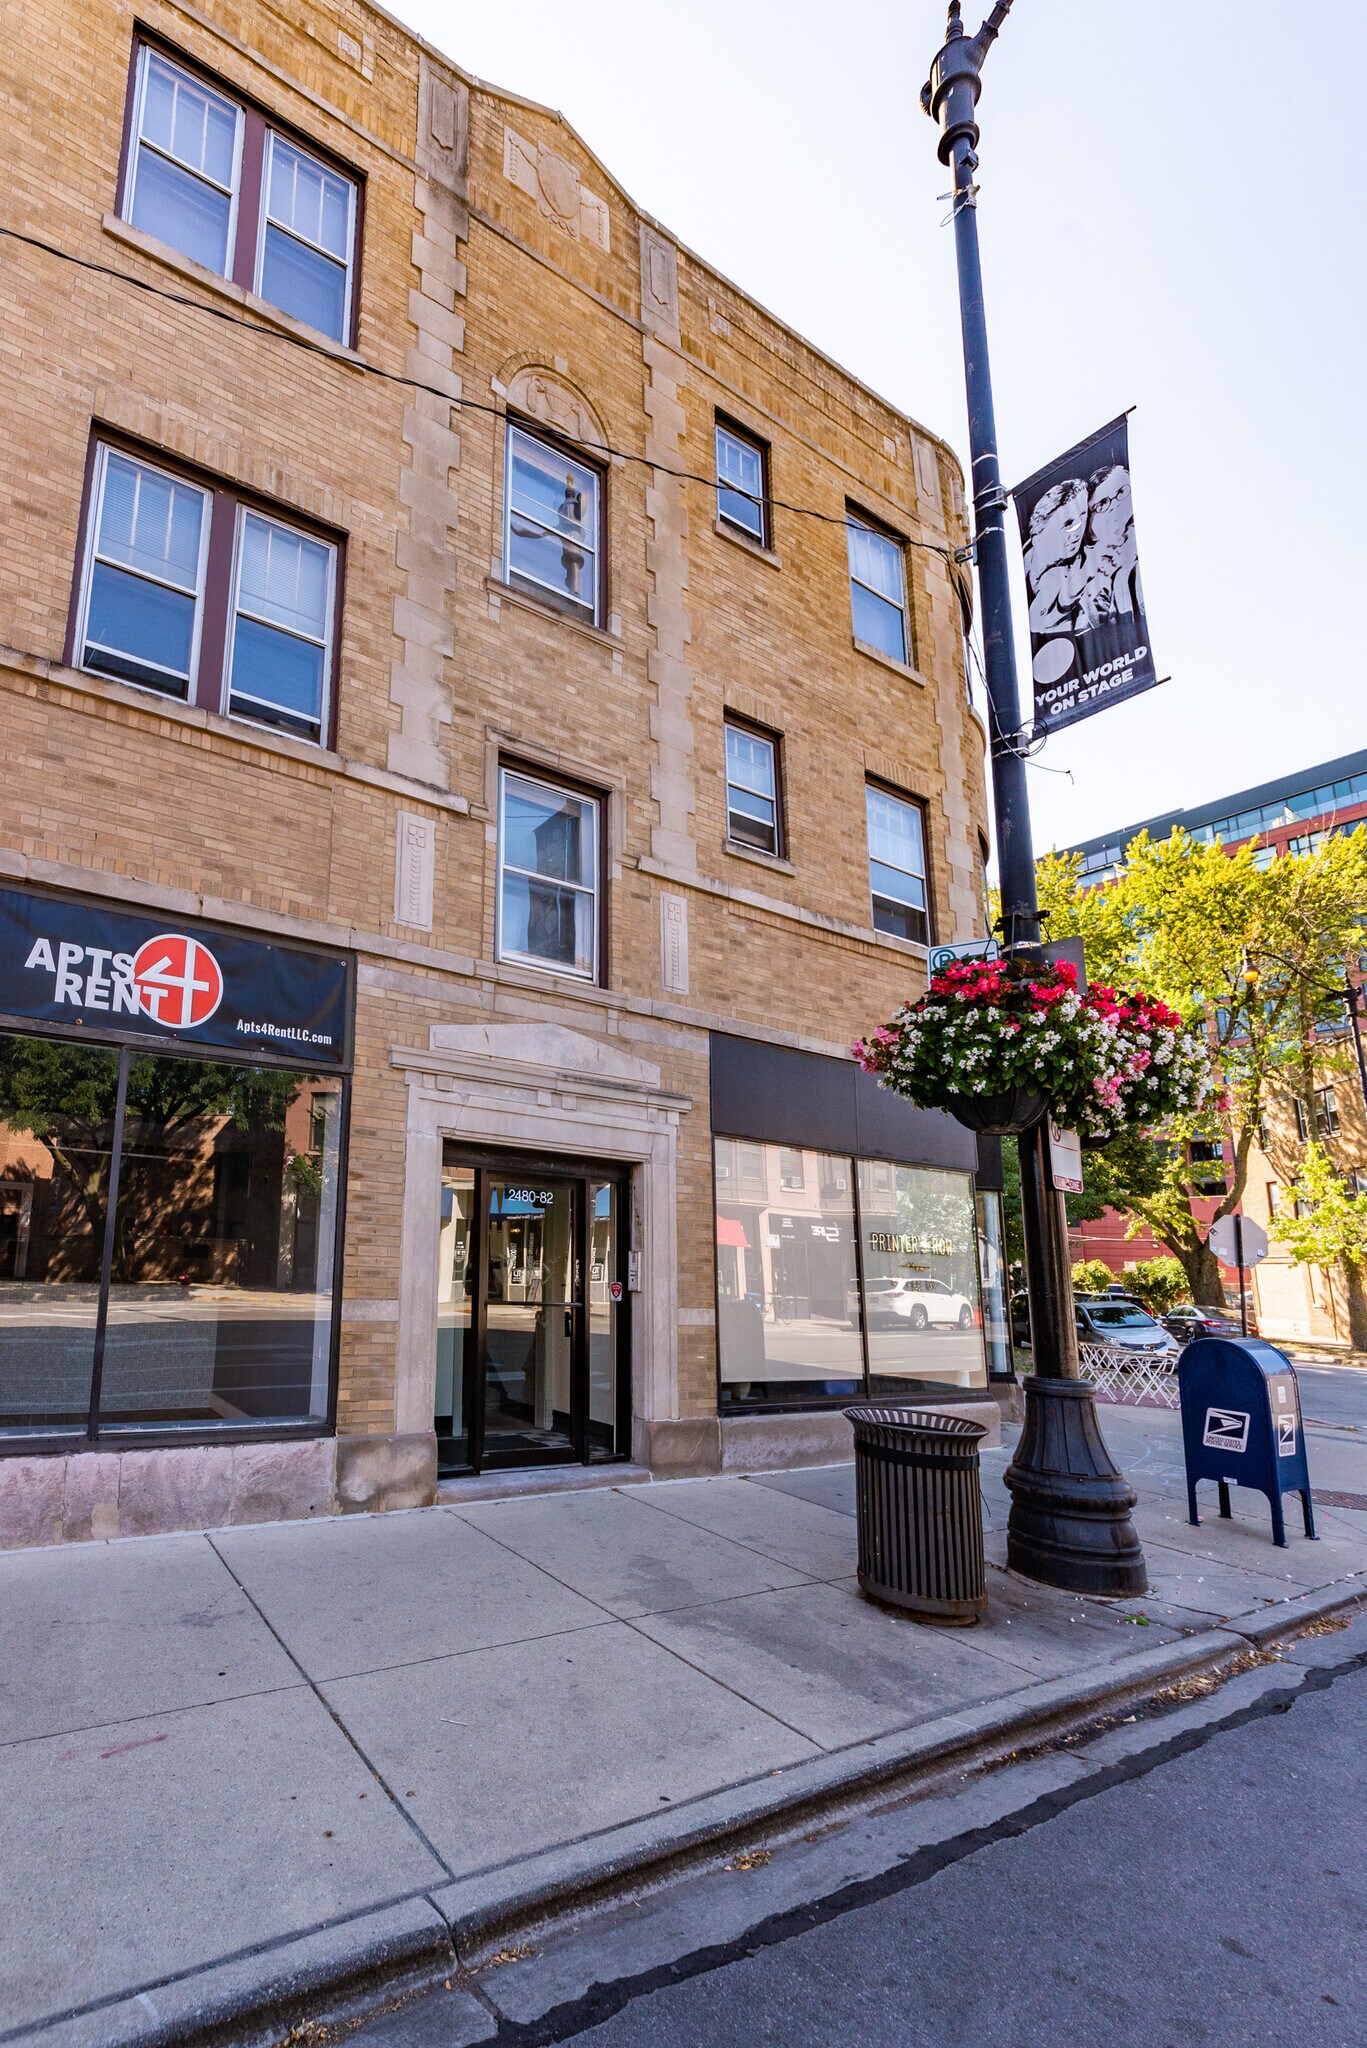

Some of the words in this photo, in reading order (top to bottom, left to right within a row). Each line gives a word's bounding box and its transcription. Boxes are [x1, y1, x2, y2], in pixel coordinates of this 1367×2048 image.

[1035, 679, 1080, 706] YOUR
[1082, 646, 1148, 685] WORLD
[1050, 696, 1075, 715] ON
[1077, 668, 1134, 703] STAGE
[24, 937, 136, 985] APTS
[134, 939, 210, 1025] 4
[54, 972, 168, 1019] RENT
[236, 1018, 333, 1045] Apts4RentLLC.com
[508, 1188, 554, 1204] 2480-82
[871, 1232, 927, 1254] PRINTER'S
[1206, 1439, 1223, 1447] POSTAL
[1223, 1442, 1242, 1450] SERVICE
